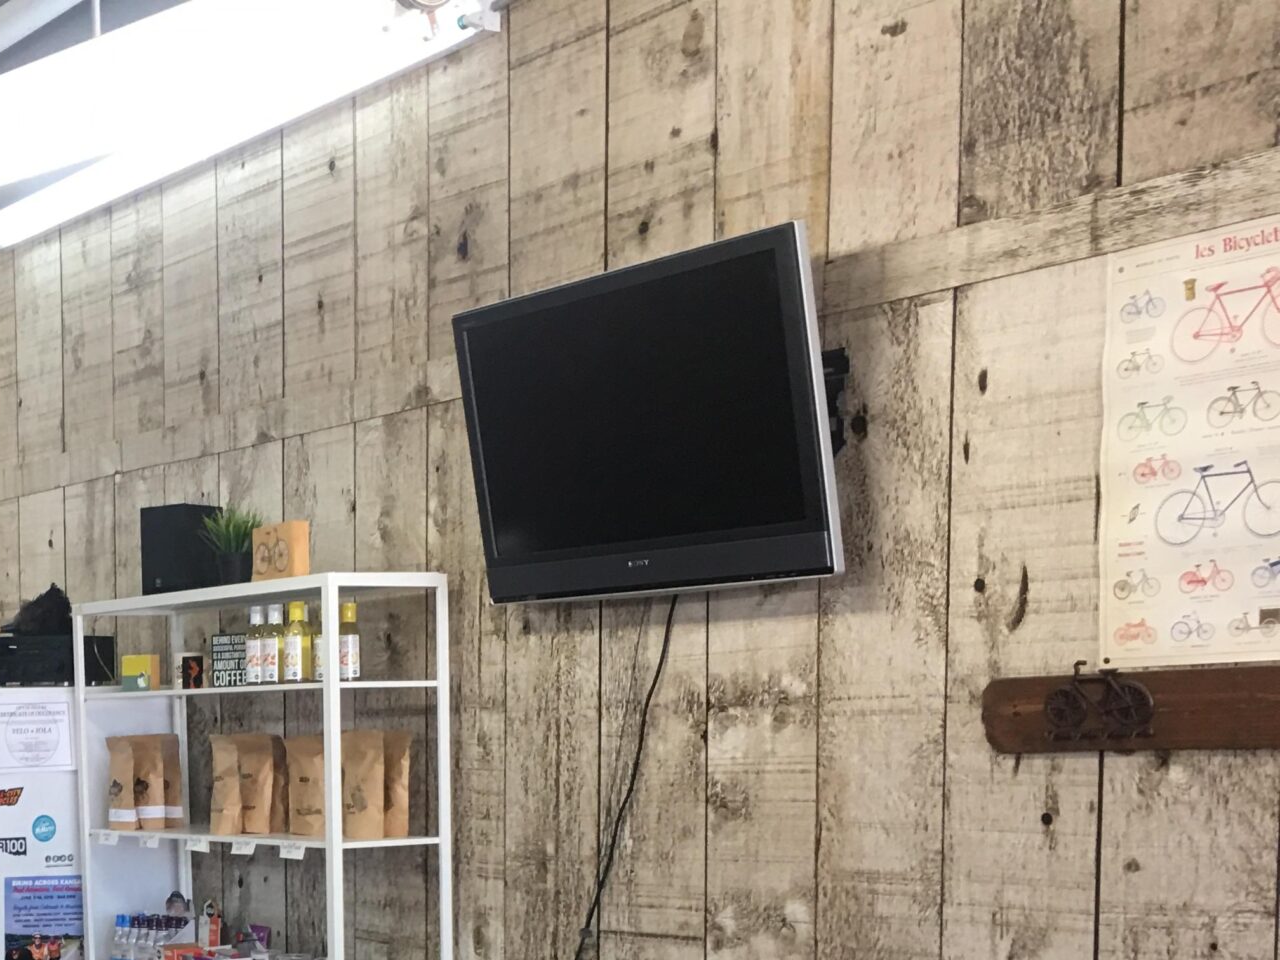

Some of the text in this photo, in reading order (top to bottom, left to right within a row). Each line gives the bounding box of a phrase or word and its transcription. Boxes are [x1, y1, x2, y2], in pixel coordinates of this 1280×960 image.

[1194, 243, 1216, 260] les
[213, 660, 239, 670] AMOUNT
[213, 670, 248, 687] COFFEE
